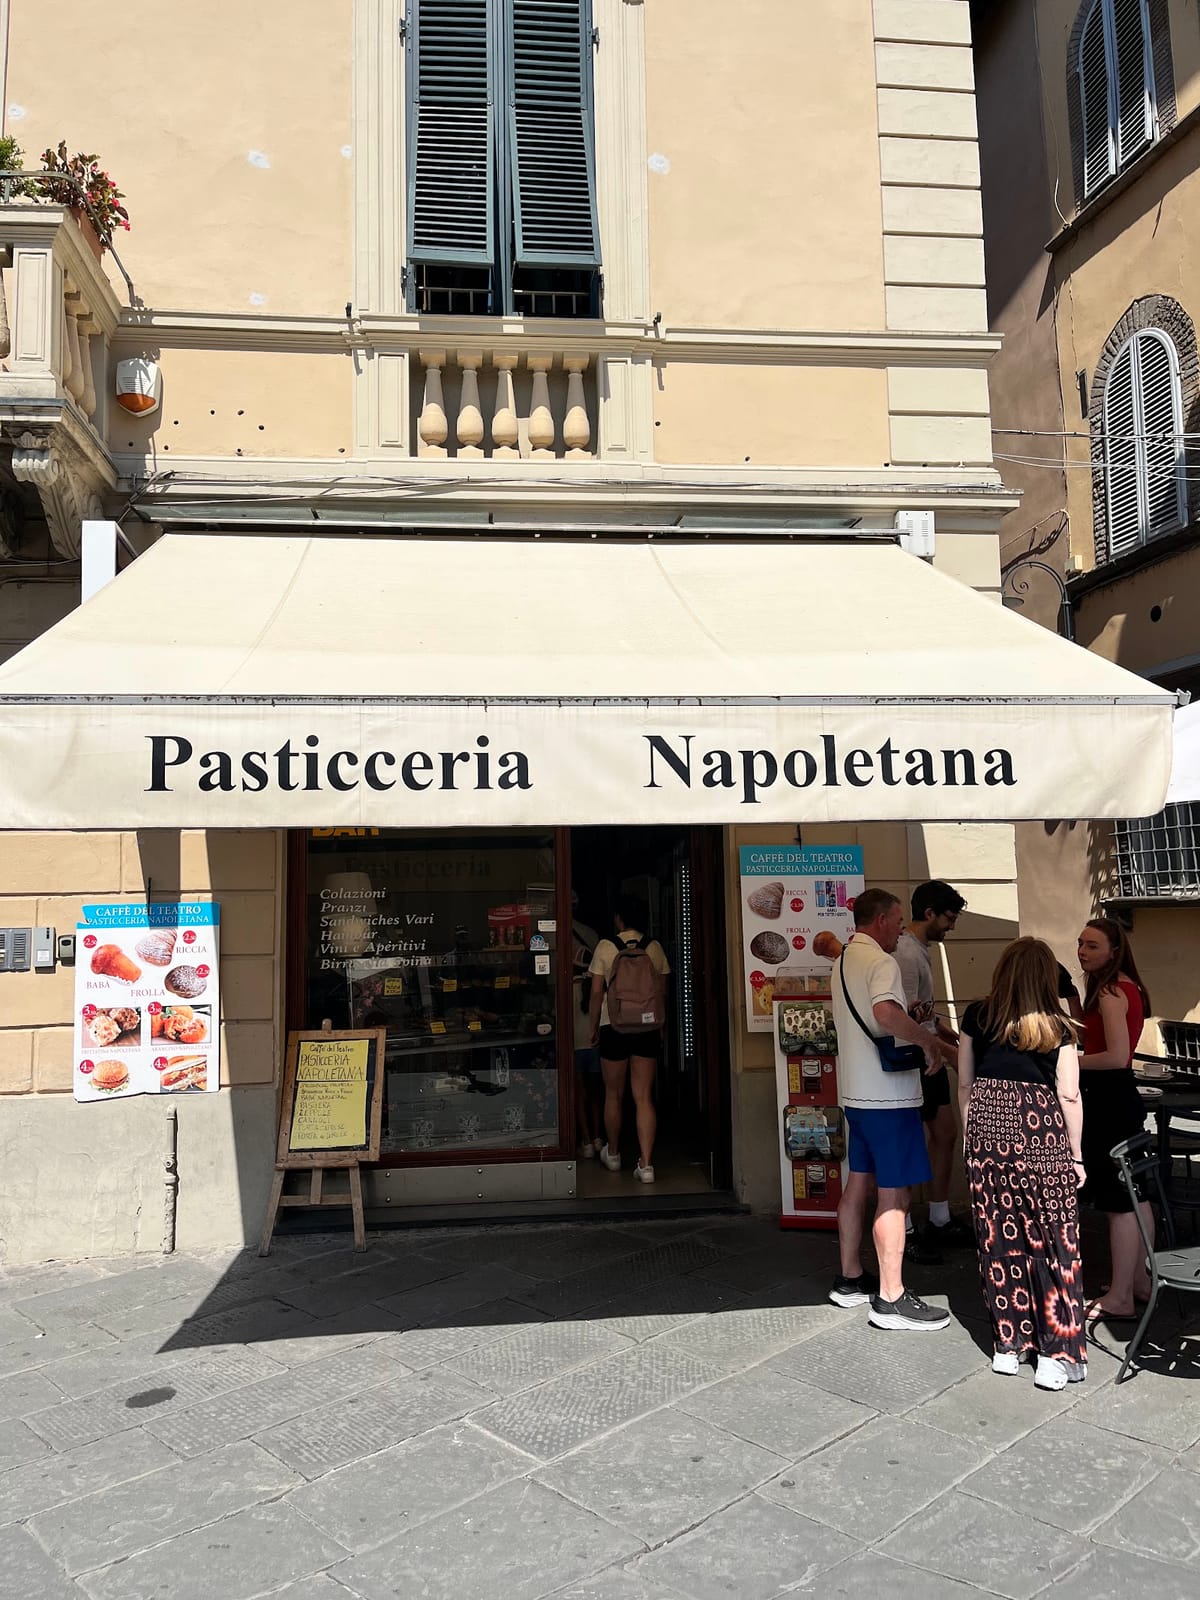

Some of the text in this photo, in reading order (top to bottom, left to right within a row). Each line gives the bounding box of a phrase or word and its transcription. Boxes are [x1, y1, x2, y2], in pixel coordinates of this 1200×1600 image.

[144, 734, 1017, 804] Pasticceria Napoletana
[751, 851, 853, 863] CAFFÈ DEL TEATRO
[746, 864, 859, 873] PASTICCERIA NAPOLETANA
[320, 887, 387, 900] Colazioni
[96, 905, 201, 917] CAFFÈ DEL TEATRO
[320, 902, 367, 913] Pranzi
[87, 915, 210, 926] PASTICCERIA NAPOLETANA
[320, 913, 435, 927] Sandwiches Vari
[320, 942, 348, 954] Vini
[130, 988, 166, 997] FROLLA
[298, 1065, 364, 1080] NAPOLETANA
